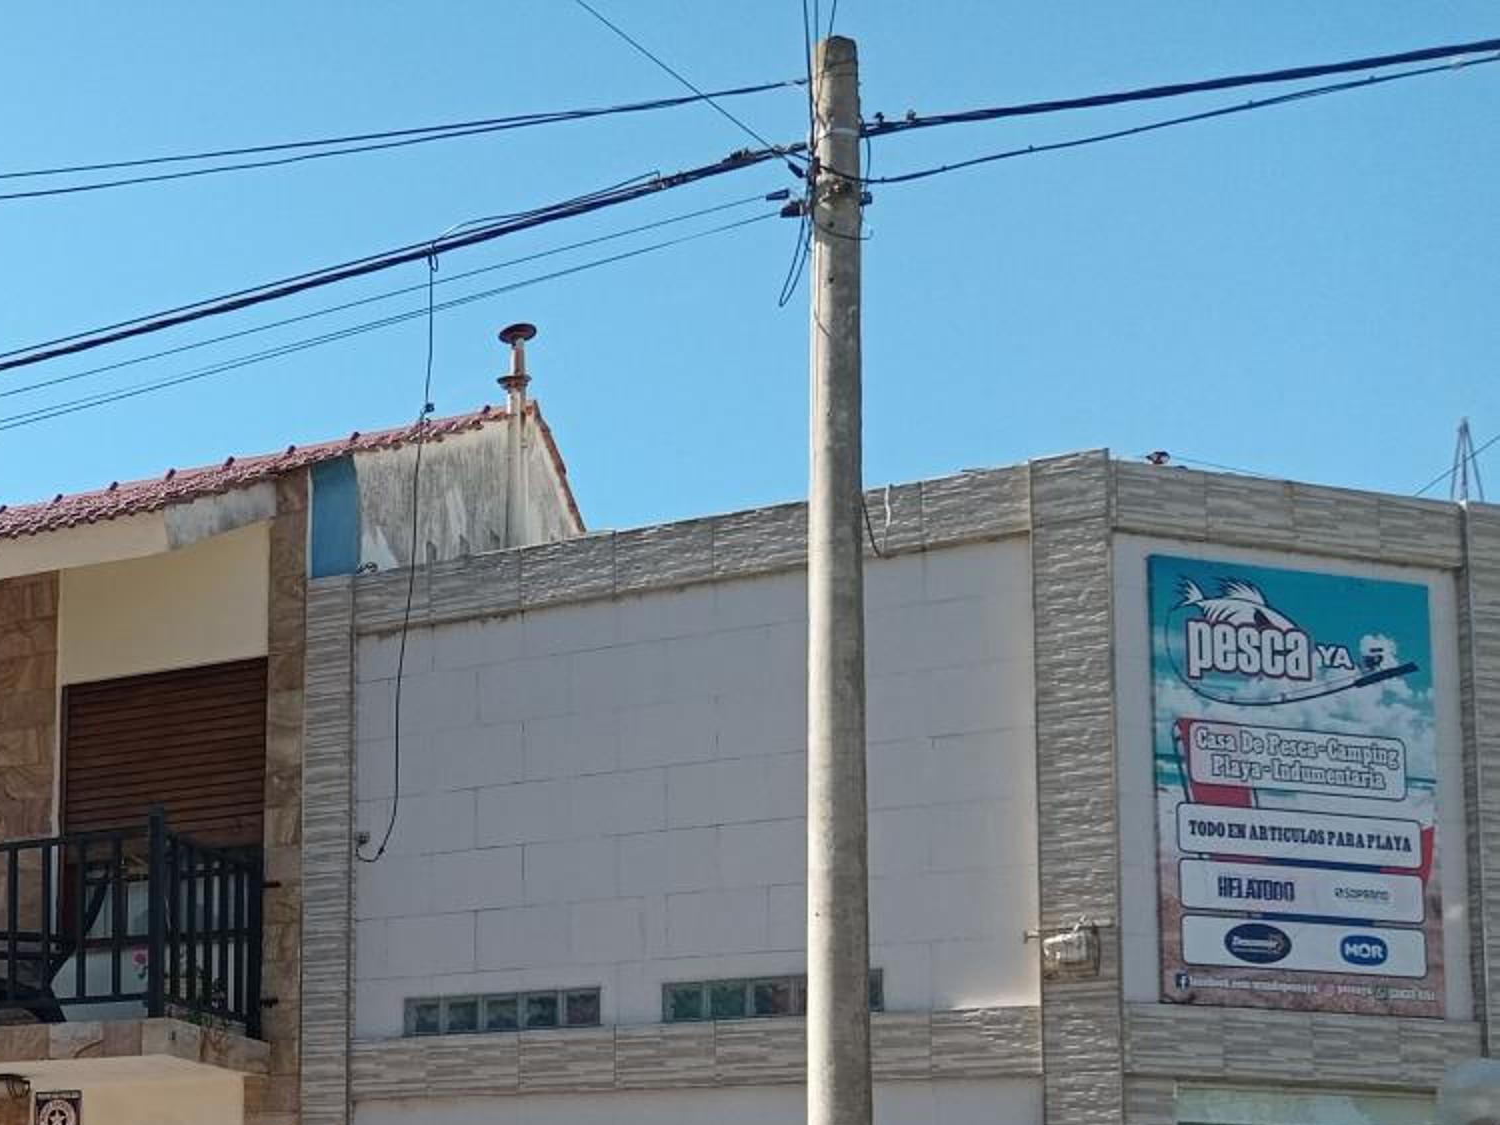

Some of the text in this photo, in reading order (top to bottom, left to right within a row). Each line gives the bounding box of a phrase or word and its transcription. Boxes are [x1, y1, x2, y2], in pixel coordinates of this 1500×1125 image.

[1187, 619, 1354, 681] pesca YA
[1196, 727, 1237, 751] Casa
[1239, 730, 1263, 755] De
[1188, 820, 1412, 852] TODO EN ARTICULOS PARA PLAYA
